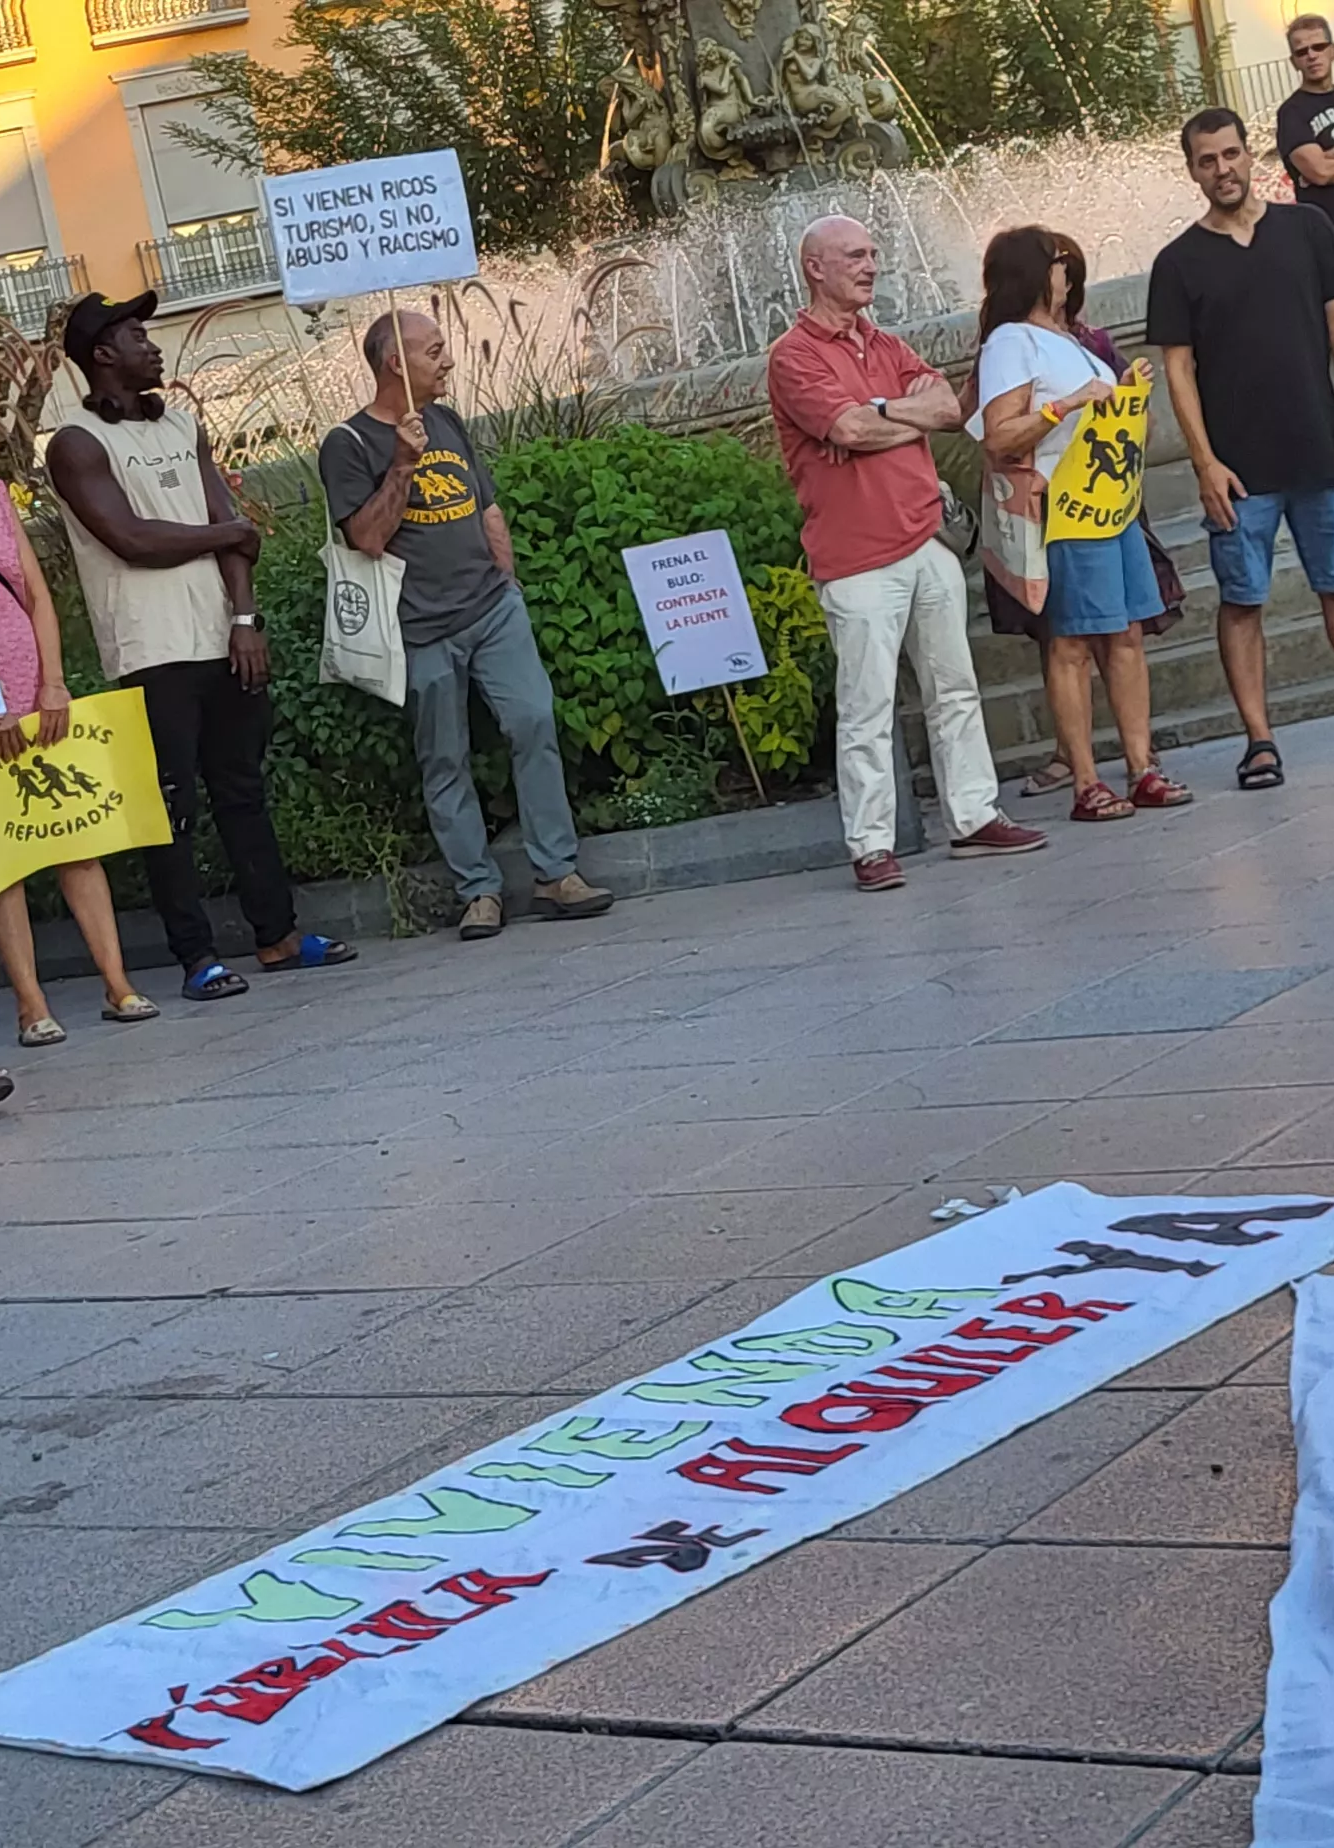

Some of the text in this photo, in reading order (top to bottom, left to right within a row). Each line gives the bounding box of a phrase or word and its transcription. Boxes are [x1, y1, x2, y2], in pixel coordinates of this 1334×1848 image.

[273, 175, 437, 218] SI VIENEN RICOS
[283, 203, 441, 246] TURISMO, SI NO,
[285, 227, 460, 270] ABUSO Y RACISMO
[651, 550, 709, 572] FRENA EL
[667, 572, 705, 589] BULO:
[655, 587, 728, 612] CONTRASTA
[665, 607, 730, 631] LA FUENTE
[3, 790, 124, 842] REFUGIADXS
[668, 1290, 1136, 1495] ALQUILER
[139, 1276, 1006, 1631] VIVIENDA
[583, 1519, 772, 1574] DE
